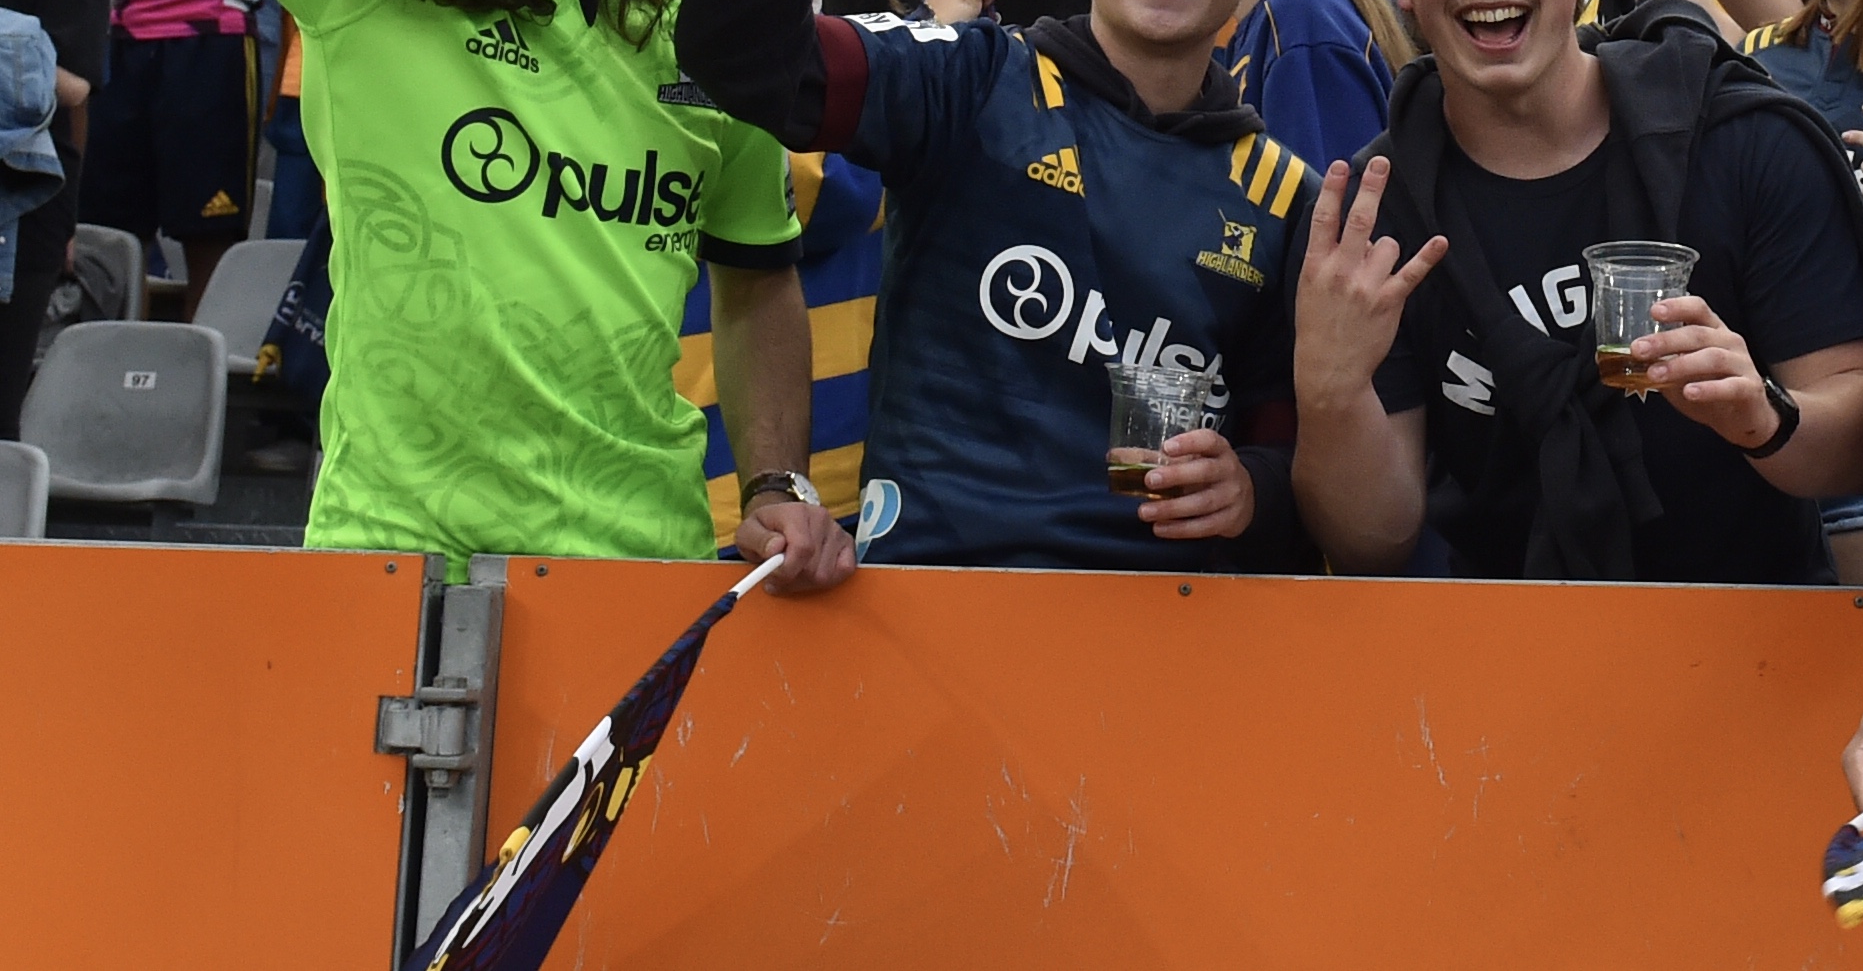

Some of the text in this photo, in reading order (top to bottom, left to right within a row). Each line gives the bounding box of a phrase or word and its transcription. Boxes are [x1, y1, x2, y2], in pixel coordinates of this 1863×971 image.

[466, 37, 540, 74] adidas
[1027, 162, 1085, 199] adid
[1196, 250, 1265, 287] HIGHLANDERS
[132, 374, 149, 386] 97
